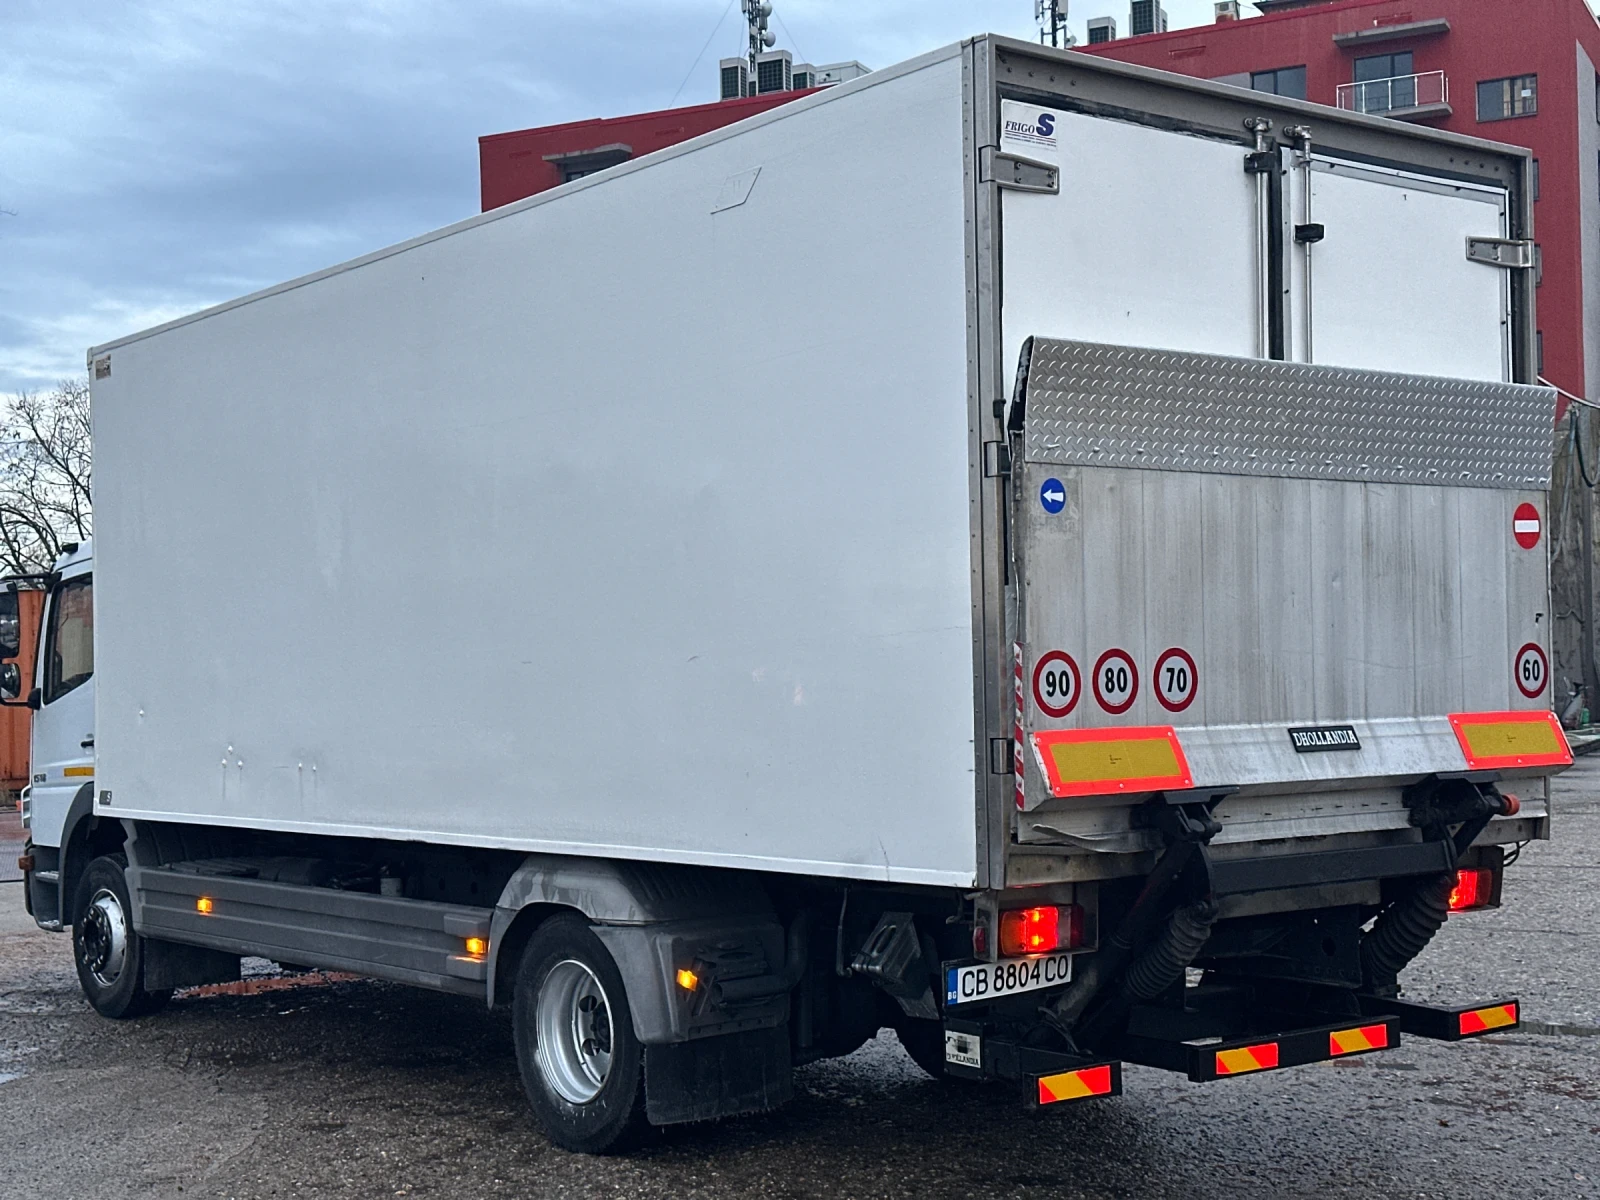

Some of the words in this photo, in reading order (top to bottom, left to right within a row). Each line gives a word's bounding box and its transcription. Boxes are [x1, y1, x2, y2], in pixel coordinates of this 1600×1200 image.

[1105, 667, 1128, 693] 80
[1166, 667, 1187, 693] 70
[1523, 659, 1540, 681] 60
[1045, 670, 1070, 697] 90
[1292, 730, 1358, 746] DHOLLANDIA
[962, 968, 989, 998] CB
[993, 959, 1041, 992] 8804
[1044, 955, 1069, 982] CO
[947, 990, 957, 1000] BG
